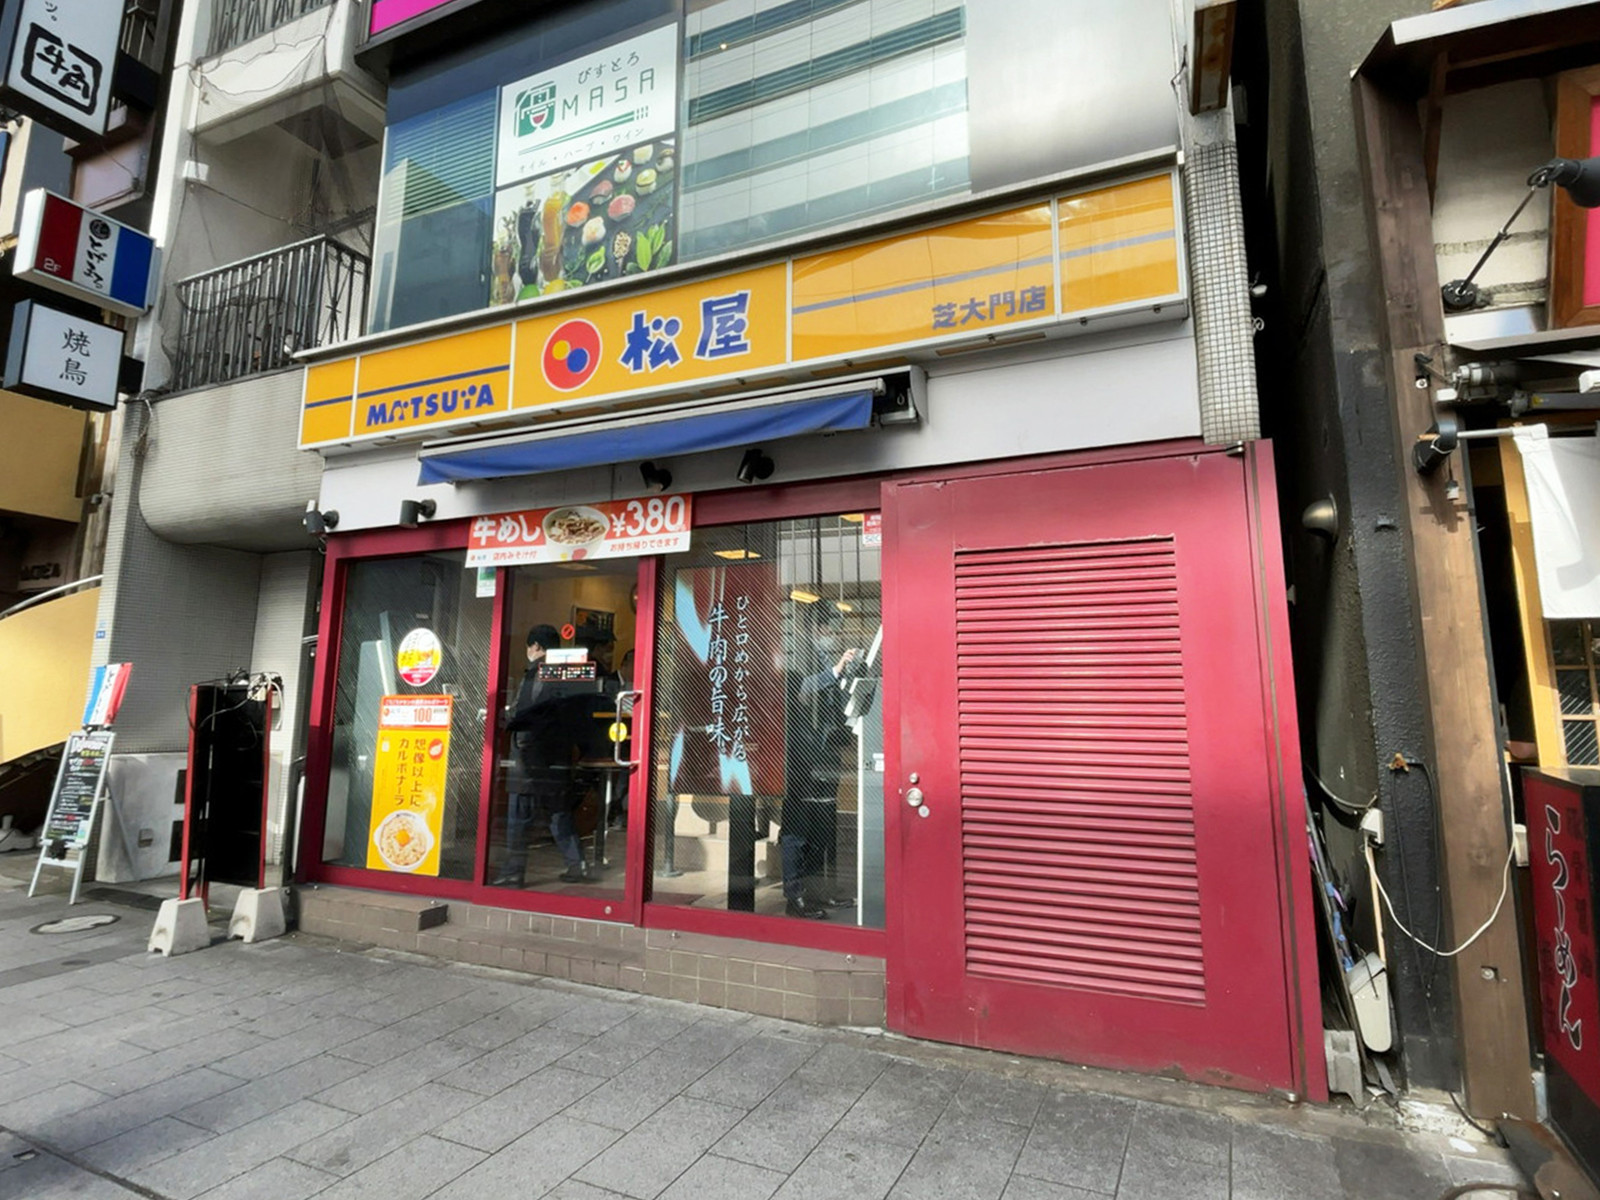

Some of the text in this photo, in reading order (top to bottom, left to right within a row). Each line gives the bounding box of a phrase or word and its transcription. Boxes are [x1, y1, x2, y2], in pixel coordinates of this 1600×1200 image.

[36, 45, 90, 99] 牛角
[562, 67, 654, 120] MASA
[43, 258, 61, 273] 2F
[932, 286, 1046, 329] 芝大門店
[617, 289, 752, 373] 松屋
[59, 327, 91, 386] 焼鳥
[366, 384, 494, 427] MATSUYA
[473, 514, 541, 546] 牛めし
[414, 707, 432, 723] 100
